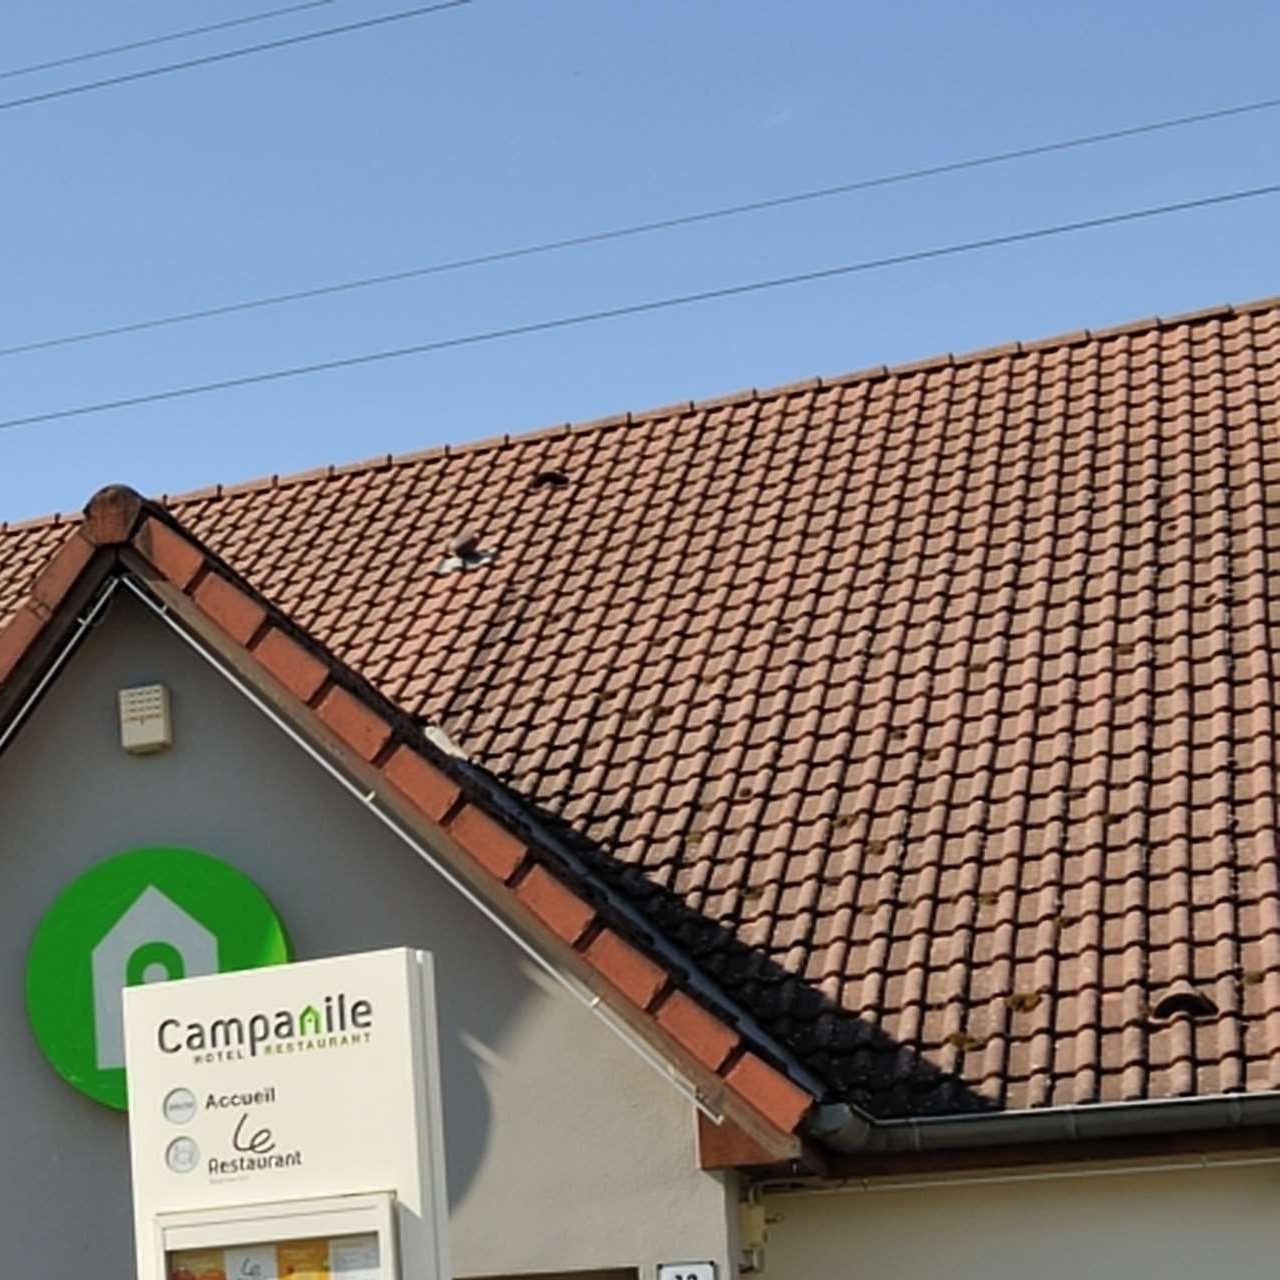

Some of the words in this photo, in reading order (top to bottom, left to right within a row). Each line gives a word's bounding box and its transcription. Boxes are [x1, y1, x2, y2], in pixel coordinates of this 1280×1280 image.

[157, 993, 373, 1057] Campanile
[193, 1050, 244, 1064] HOTEL
[263, 1032, 372, 1055] RESTAURANT
[205, 1087, 276, 1110] Accueil
[232, 1112, 277, 1154] Le
[208, 1150, 302, 1175] Restaurant
